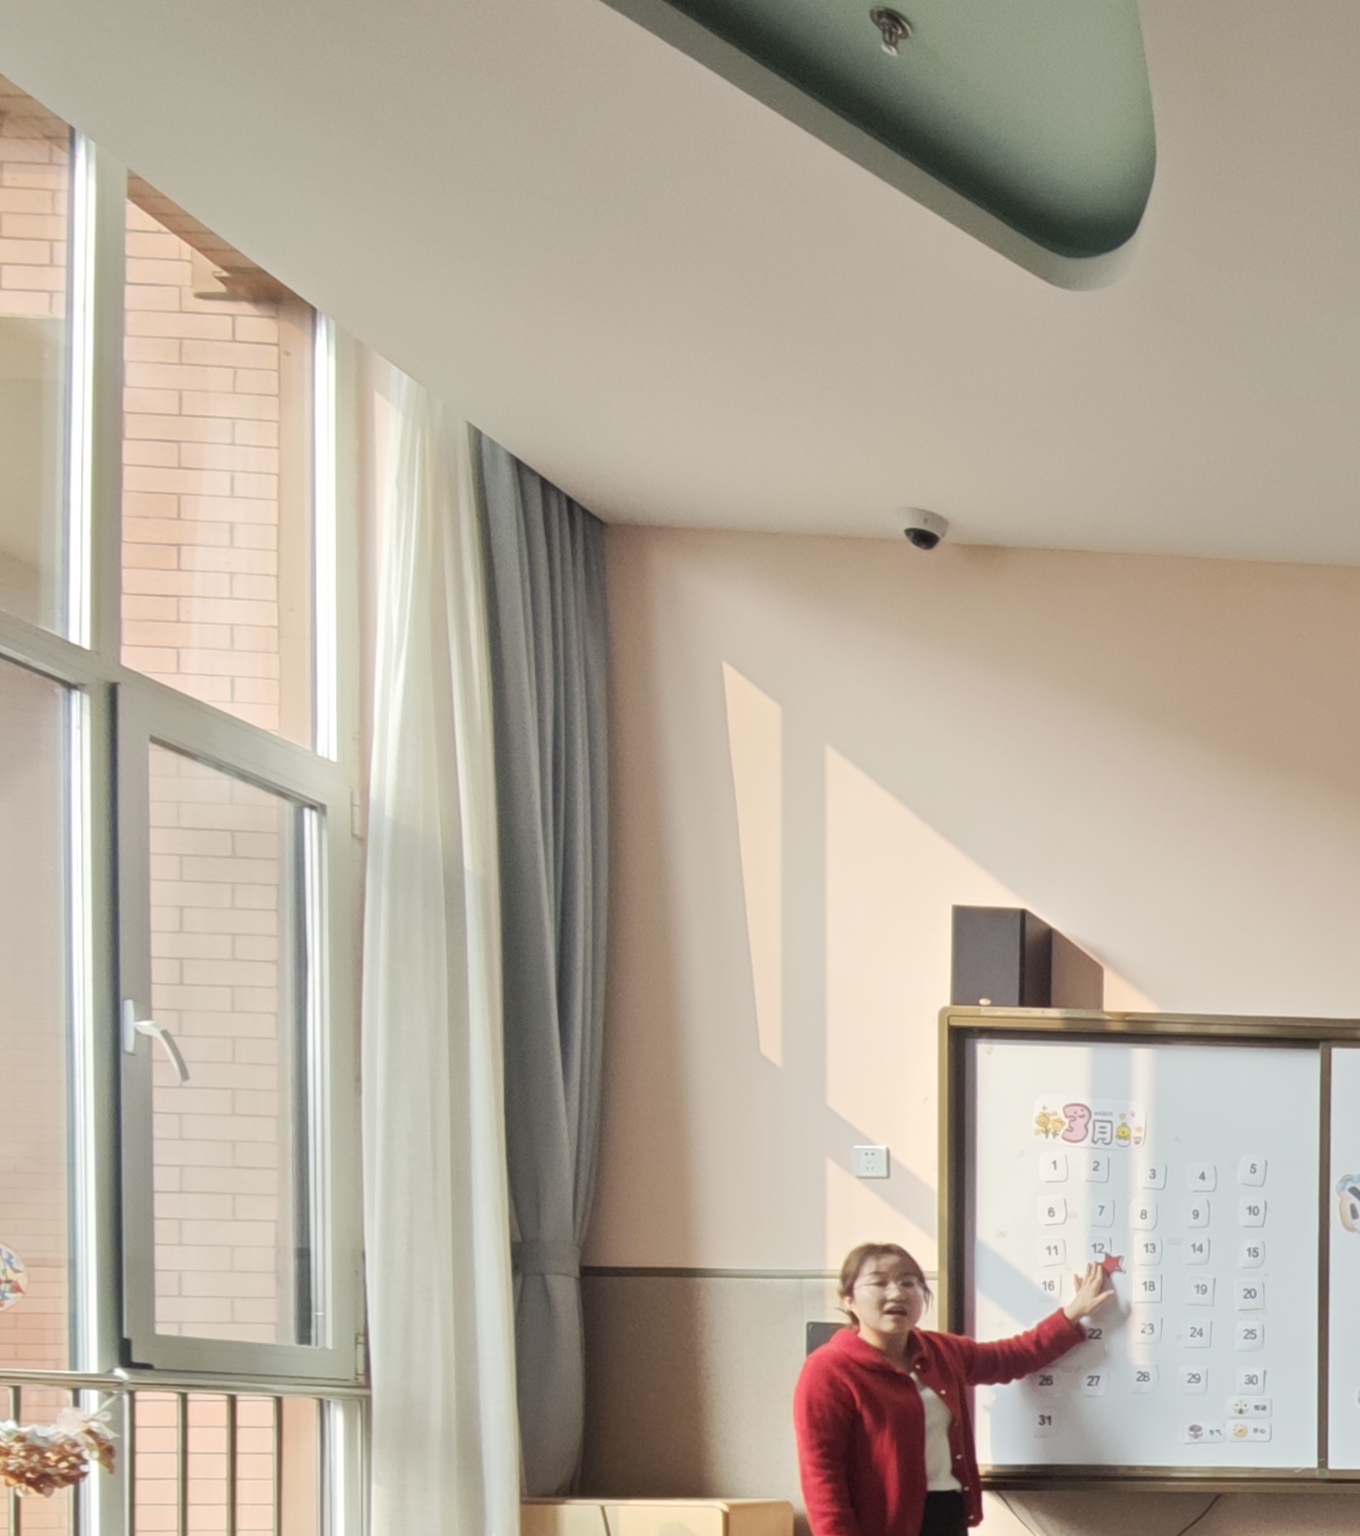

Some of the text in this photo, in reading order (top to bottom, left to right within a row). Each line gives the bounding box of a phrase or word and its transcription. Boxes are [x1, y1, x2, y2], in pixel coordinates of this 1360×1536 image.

[1061, 1103, 1114, 1145] 3月
[1051, 1159, 1258, 1182] 1 2 3 4 5
[1047, 1205, 1260, 1221] 6 7 8 9 10
[1045, 1242, 1260, 1259] 11 12 13 14 15
[1041, 1279, 1258, 1300] 16 18 19 20
[1086, 1322, 1258, 1341] 22 23 24 25
[1038, 1370, 1259, 1387] 26 27 28 29 30
[1038, 1414, 1052, 1426] 31
